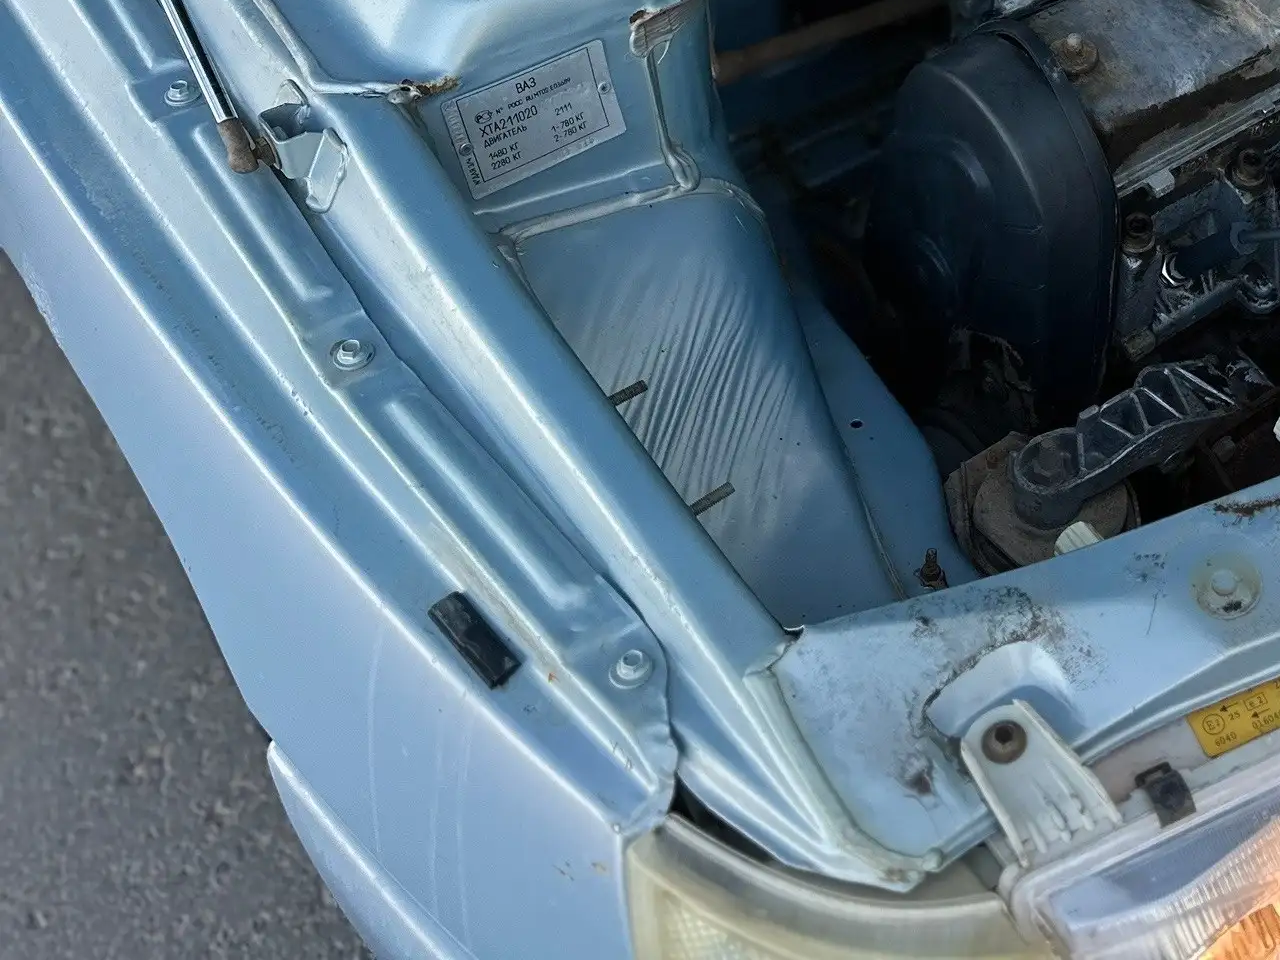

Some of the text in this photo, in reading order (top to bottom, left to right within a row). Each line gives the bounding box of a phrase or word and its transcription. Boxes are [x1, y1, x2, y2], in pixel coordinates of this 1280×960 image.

[478, 105, 538, 138] XTA211020
[482, 102, 573, 149] ДВИГАТЕЛЬ 2111
[575, 111, 585, 123] КГ
[578, 120, 588, 133] КГ
[488, 141, 520, 161] 1480 КГ
[491, 150, 522, 171] 2280 КГ
